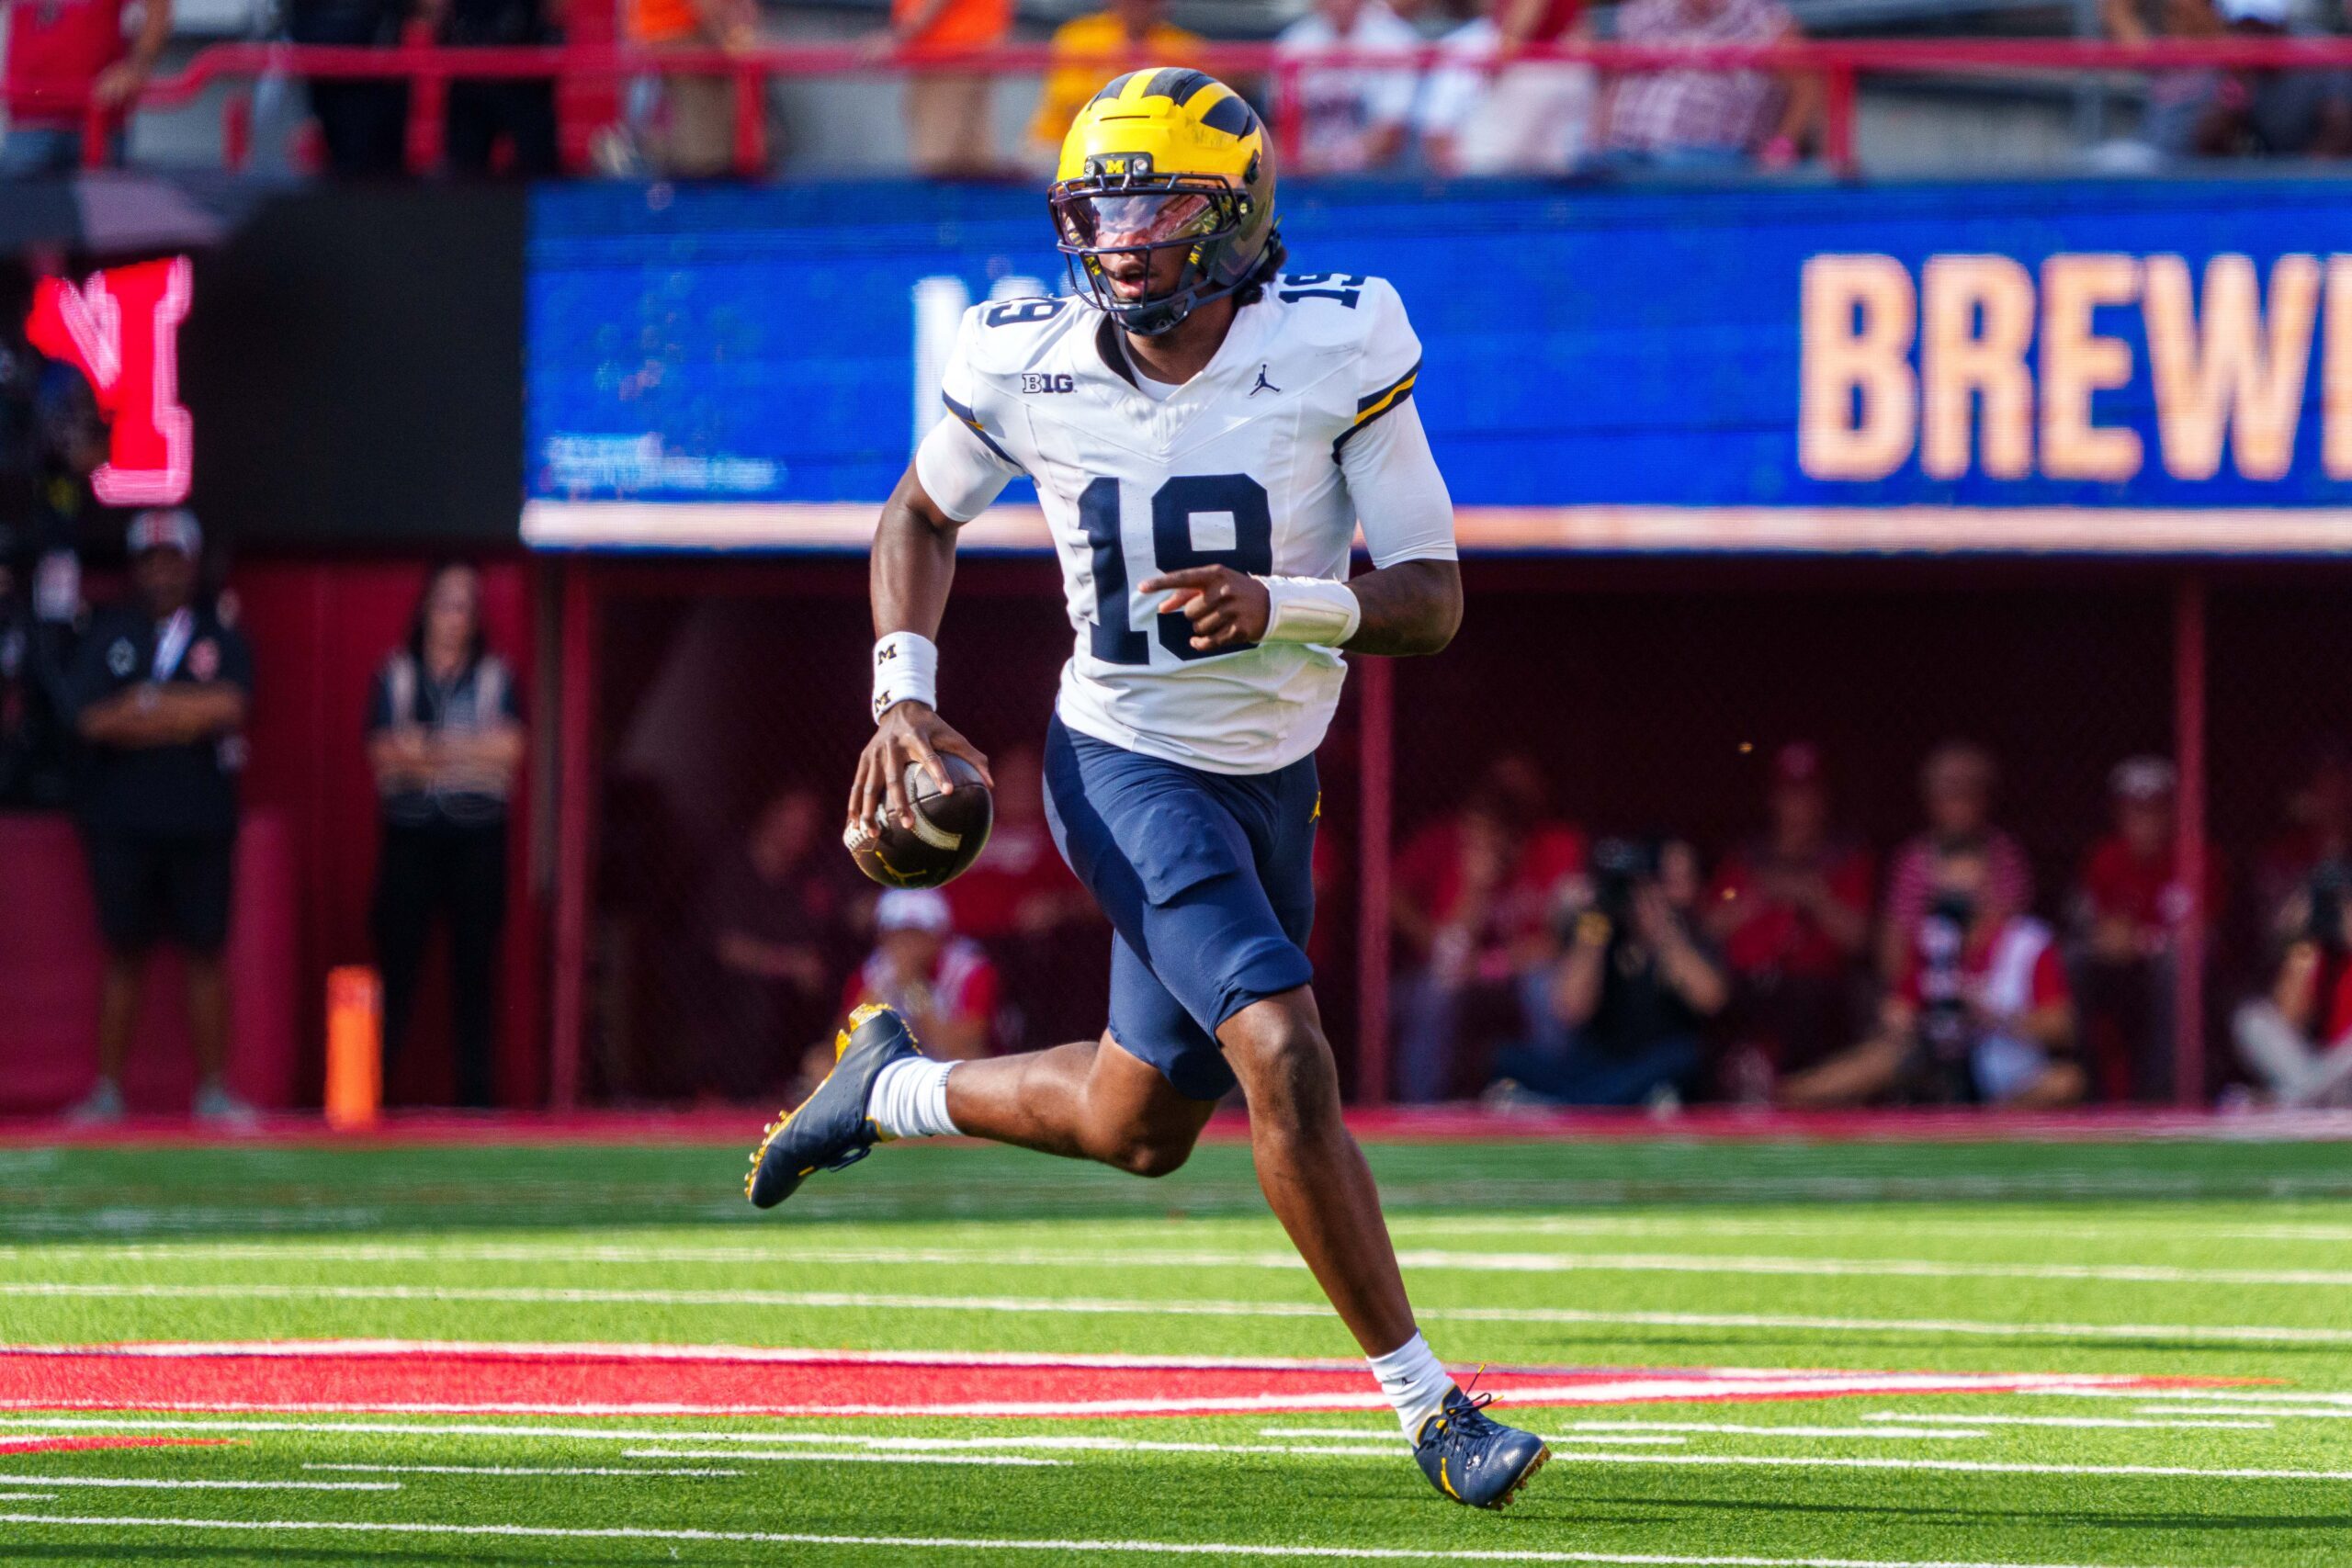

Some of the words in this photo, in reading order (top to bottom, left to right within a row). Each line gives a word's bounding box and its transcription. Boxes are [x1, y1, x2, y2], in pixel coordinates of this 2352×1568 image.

[1105, 159, 1125, 175] M
[985, 297, 1068, 328] 9
[1798, 252, 2352, 482] BREW
[1077, 472, 1272, 665] 19
[877, 643, 898, 666] M
[875, 690, 891, 714] M
